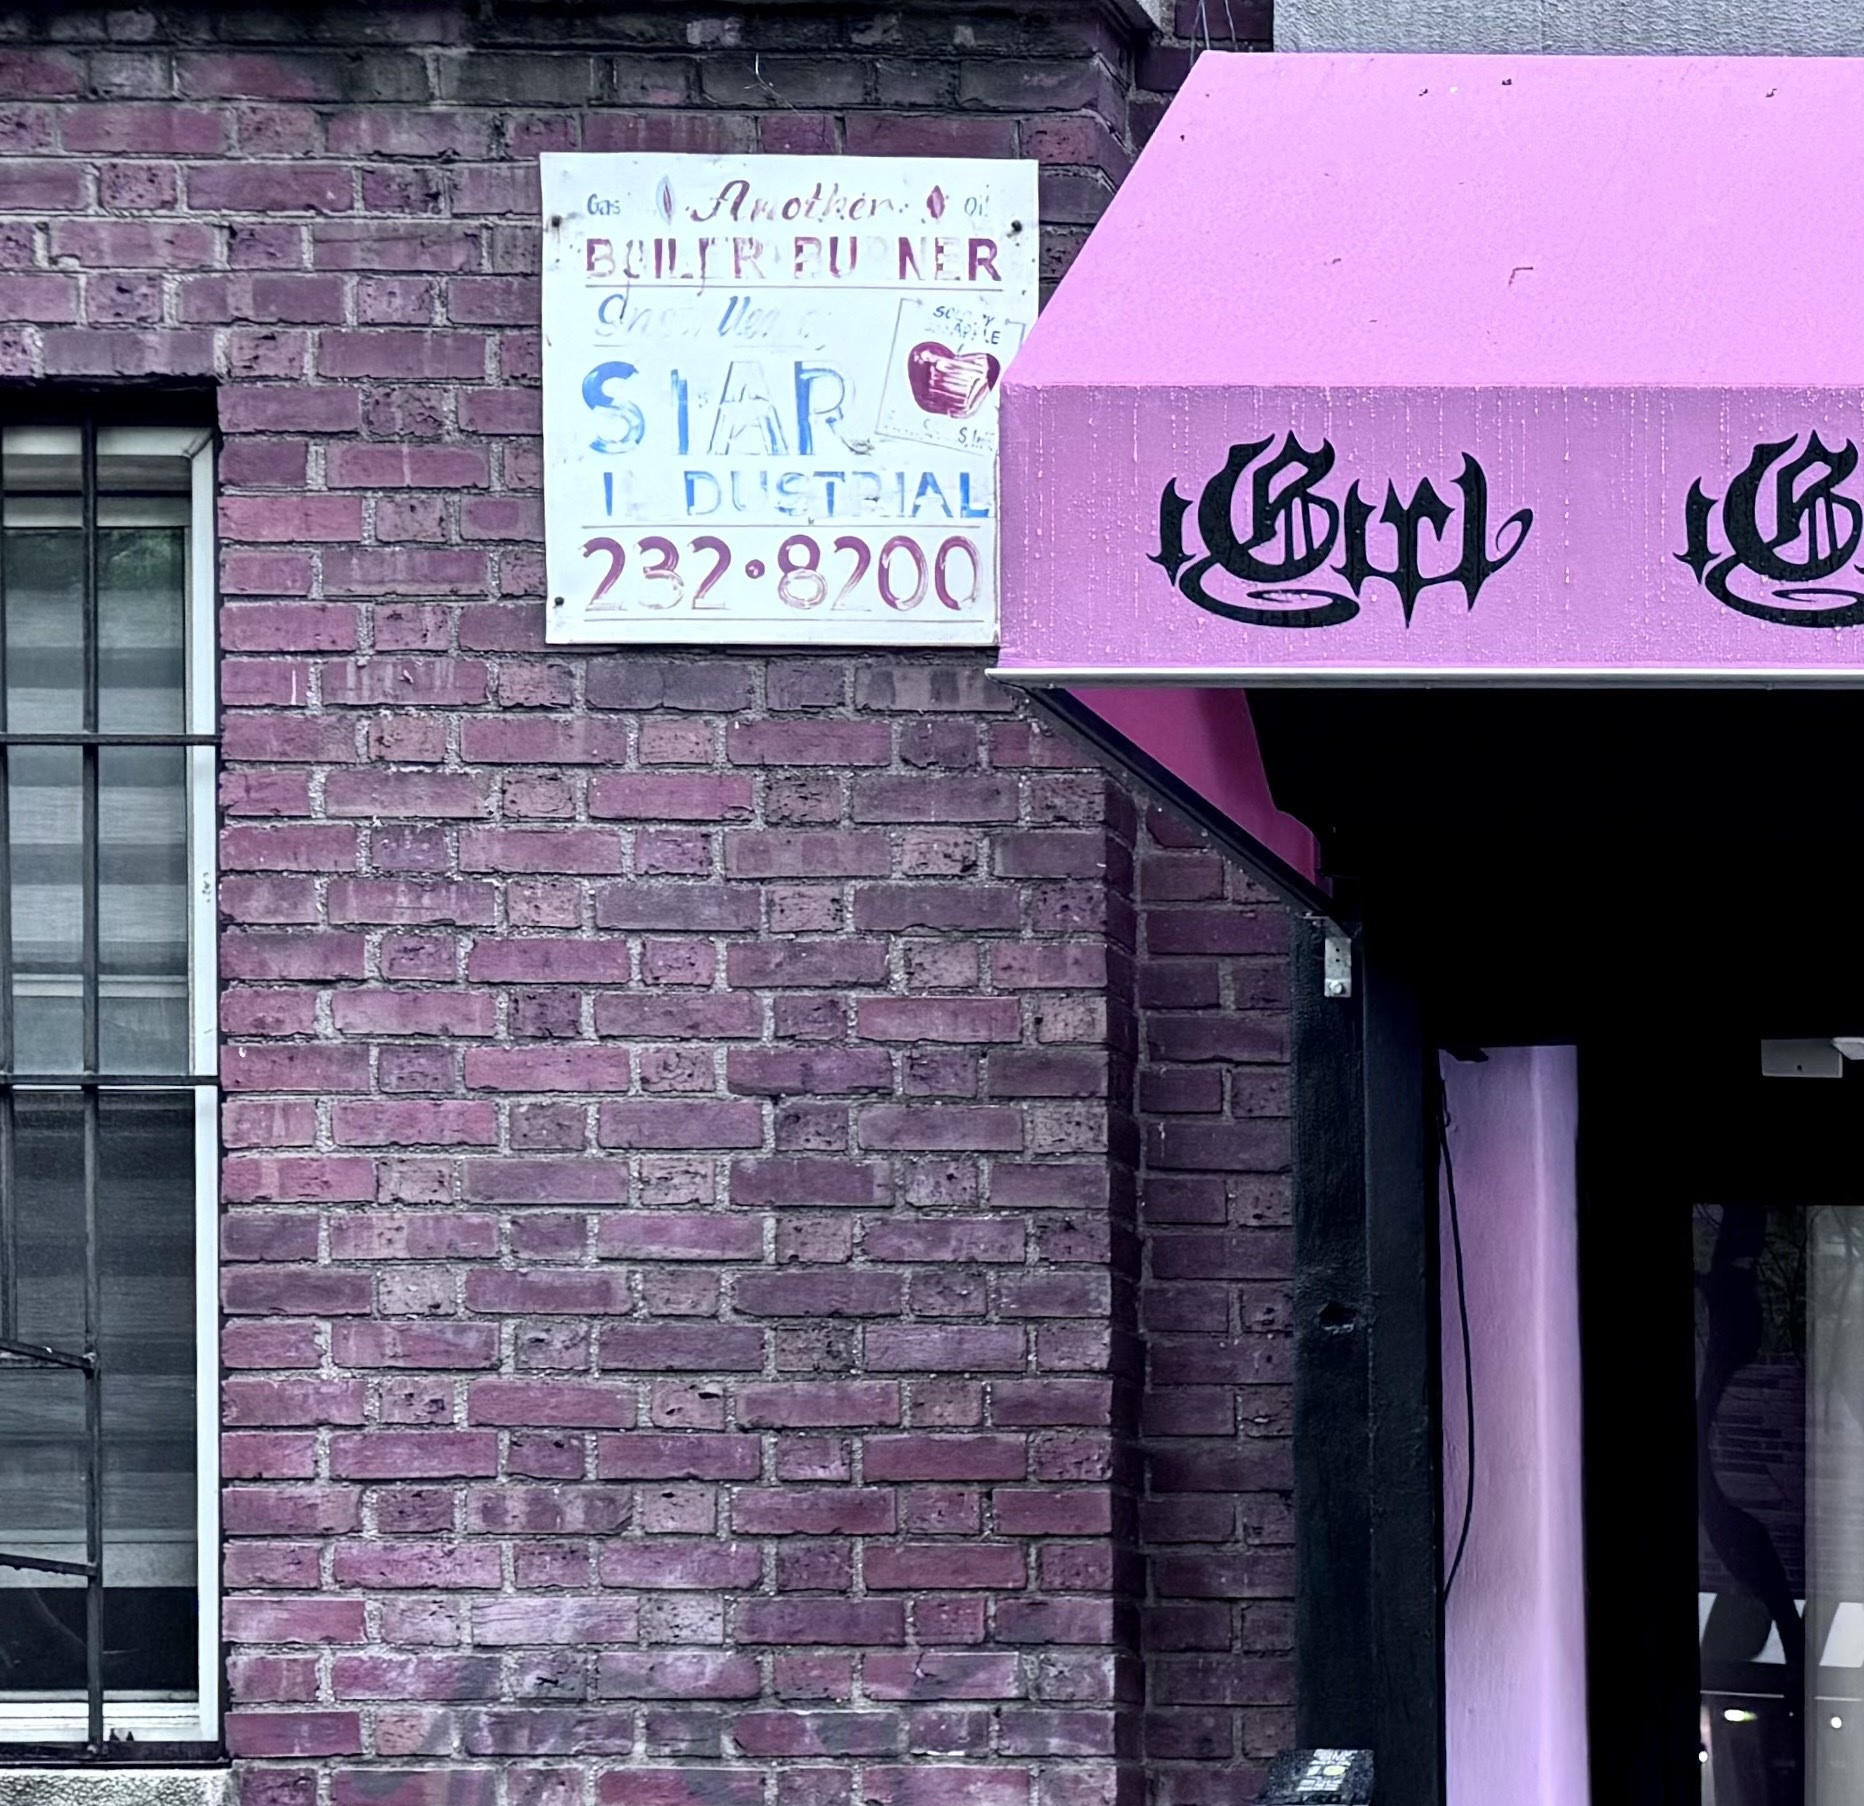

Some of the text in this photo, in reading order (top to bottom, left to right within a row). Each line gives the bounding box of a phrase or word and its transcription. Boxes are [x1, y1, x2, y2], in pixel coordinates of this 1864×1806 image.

[586, 193, 621, 216] Gas
[689, 179, 894, 222] Another
[794, 236, 1003, 282] BUNER
[603, 470, 991, 519] IDUSTRIAL
